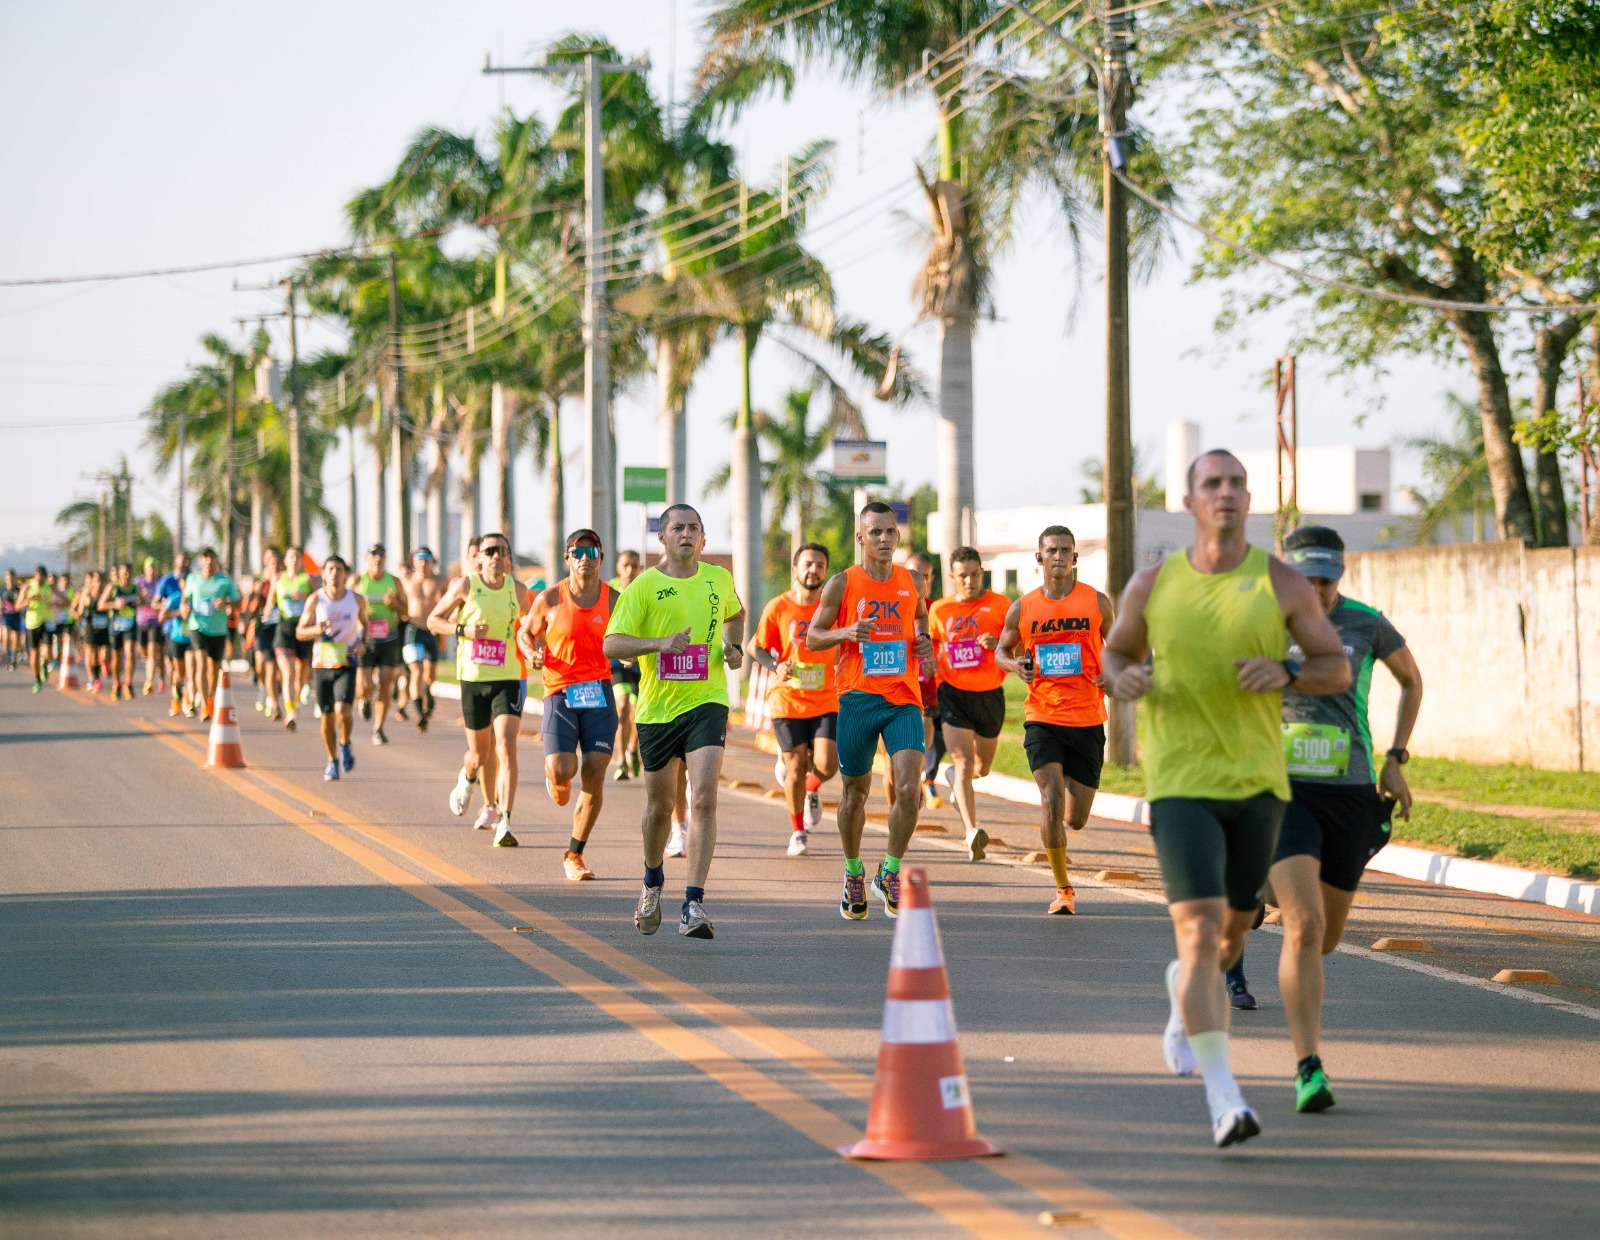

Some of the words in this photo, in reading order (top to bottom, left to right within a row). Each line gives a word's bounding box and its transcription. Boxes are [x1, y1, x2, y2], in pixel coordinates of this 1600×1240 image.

[868, 600, 901, 619] 21K
[953, 615, 980, 630] 21K
[1031, 618, 1090, 634] MANDA
[478, 644, 497, 658] 1422
[874, 651, 894, 665] 2113
[954, 646, 974, 661] 1423
[672, 655, 693, 670] 1118
[1046, 652, 1070, 666] 2203
[573, 687, 595, 700] 2565
[1293, 738, 1330, 760] 5100
